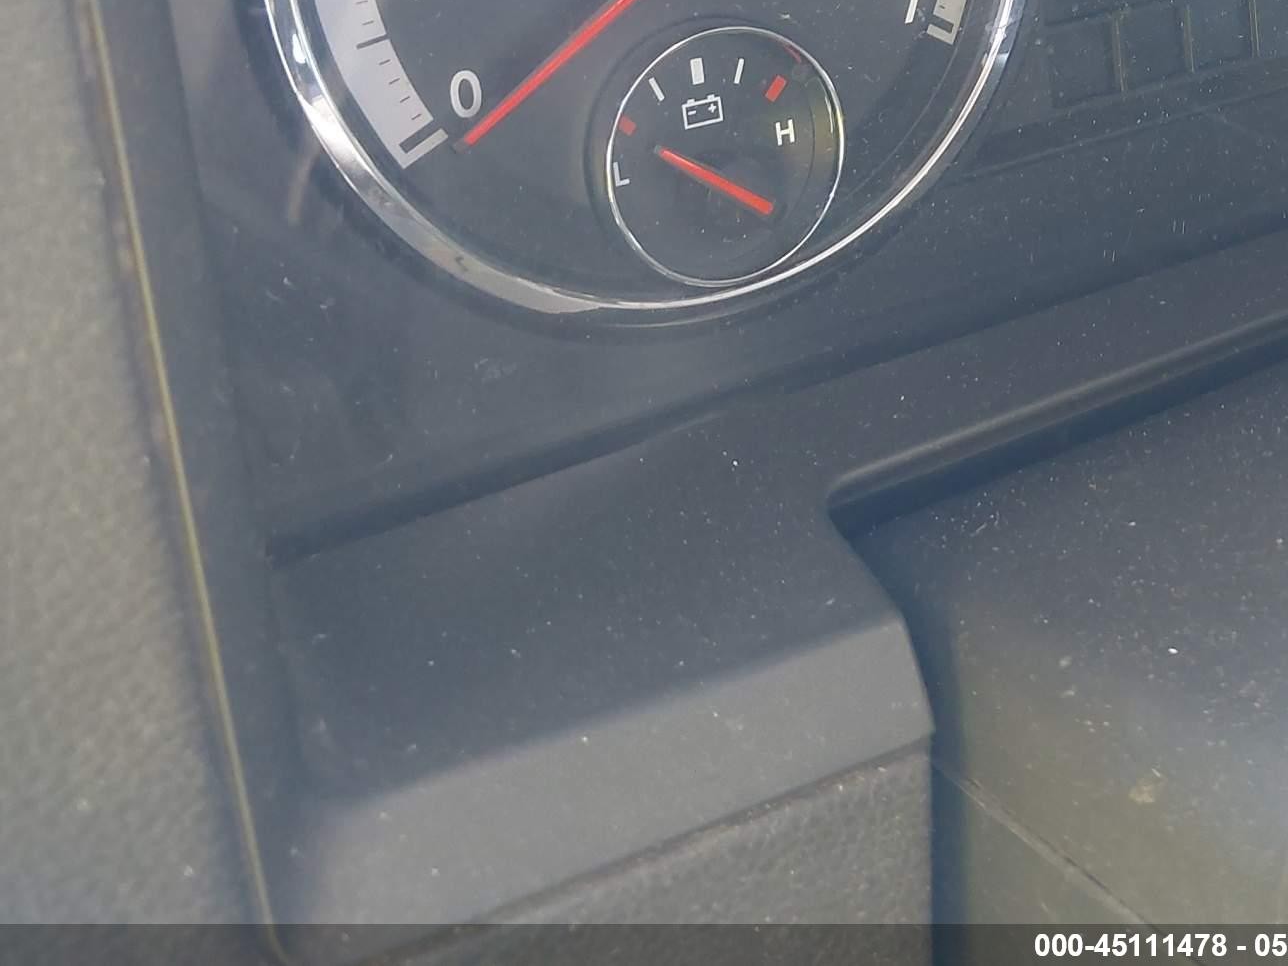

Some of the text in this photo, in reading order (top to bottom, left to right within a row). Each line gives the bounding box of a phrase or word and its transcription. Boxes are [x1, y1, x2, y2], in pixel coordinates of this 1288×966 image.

[449, 69, 483, 118] 0
[775, 118, 796, 146] H
[613, 162, 630, 187] L
